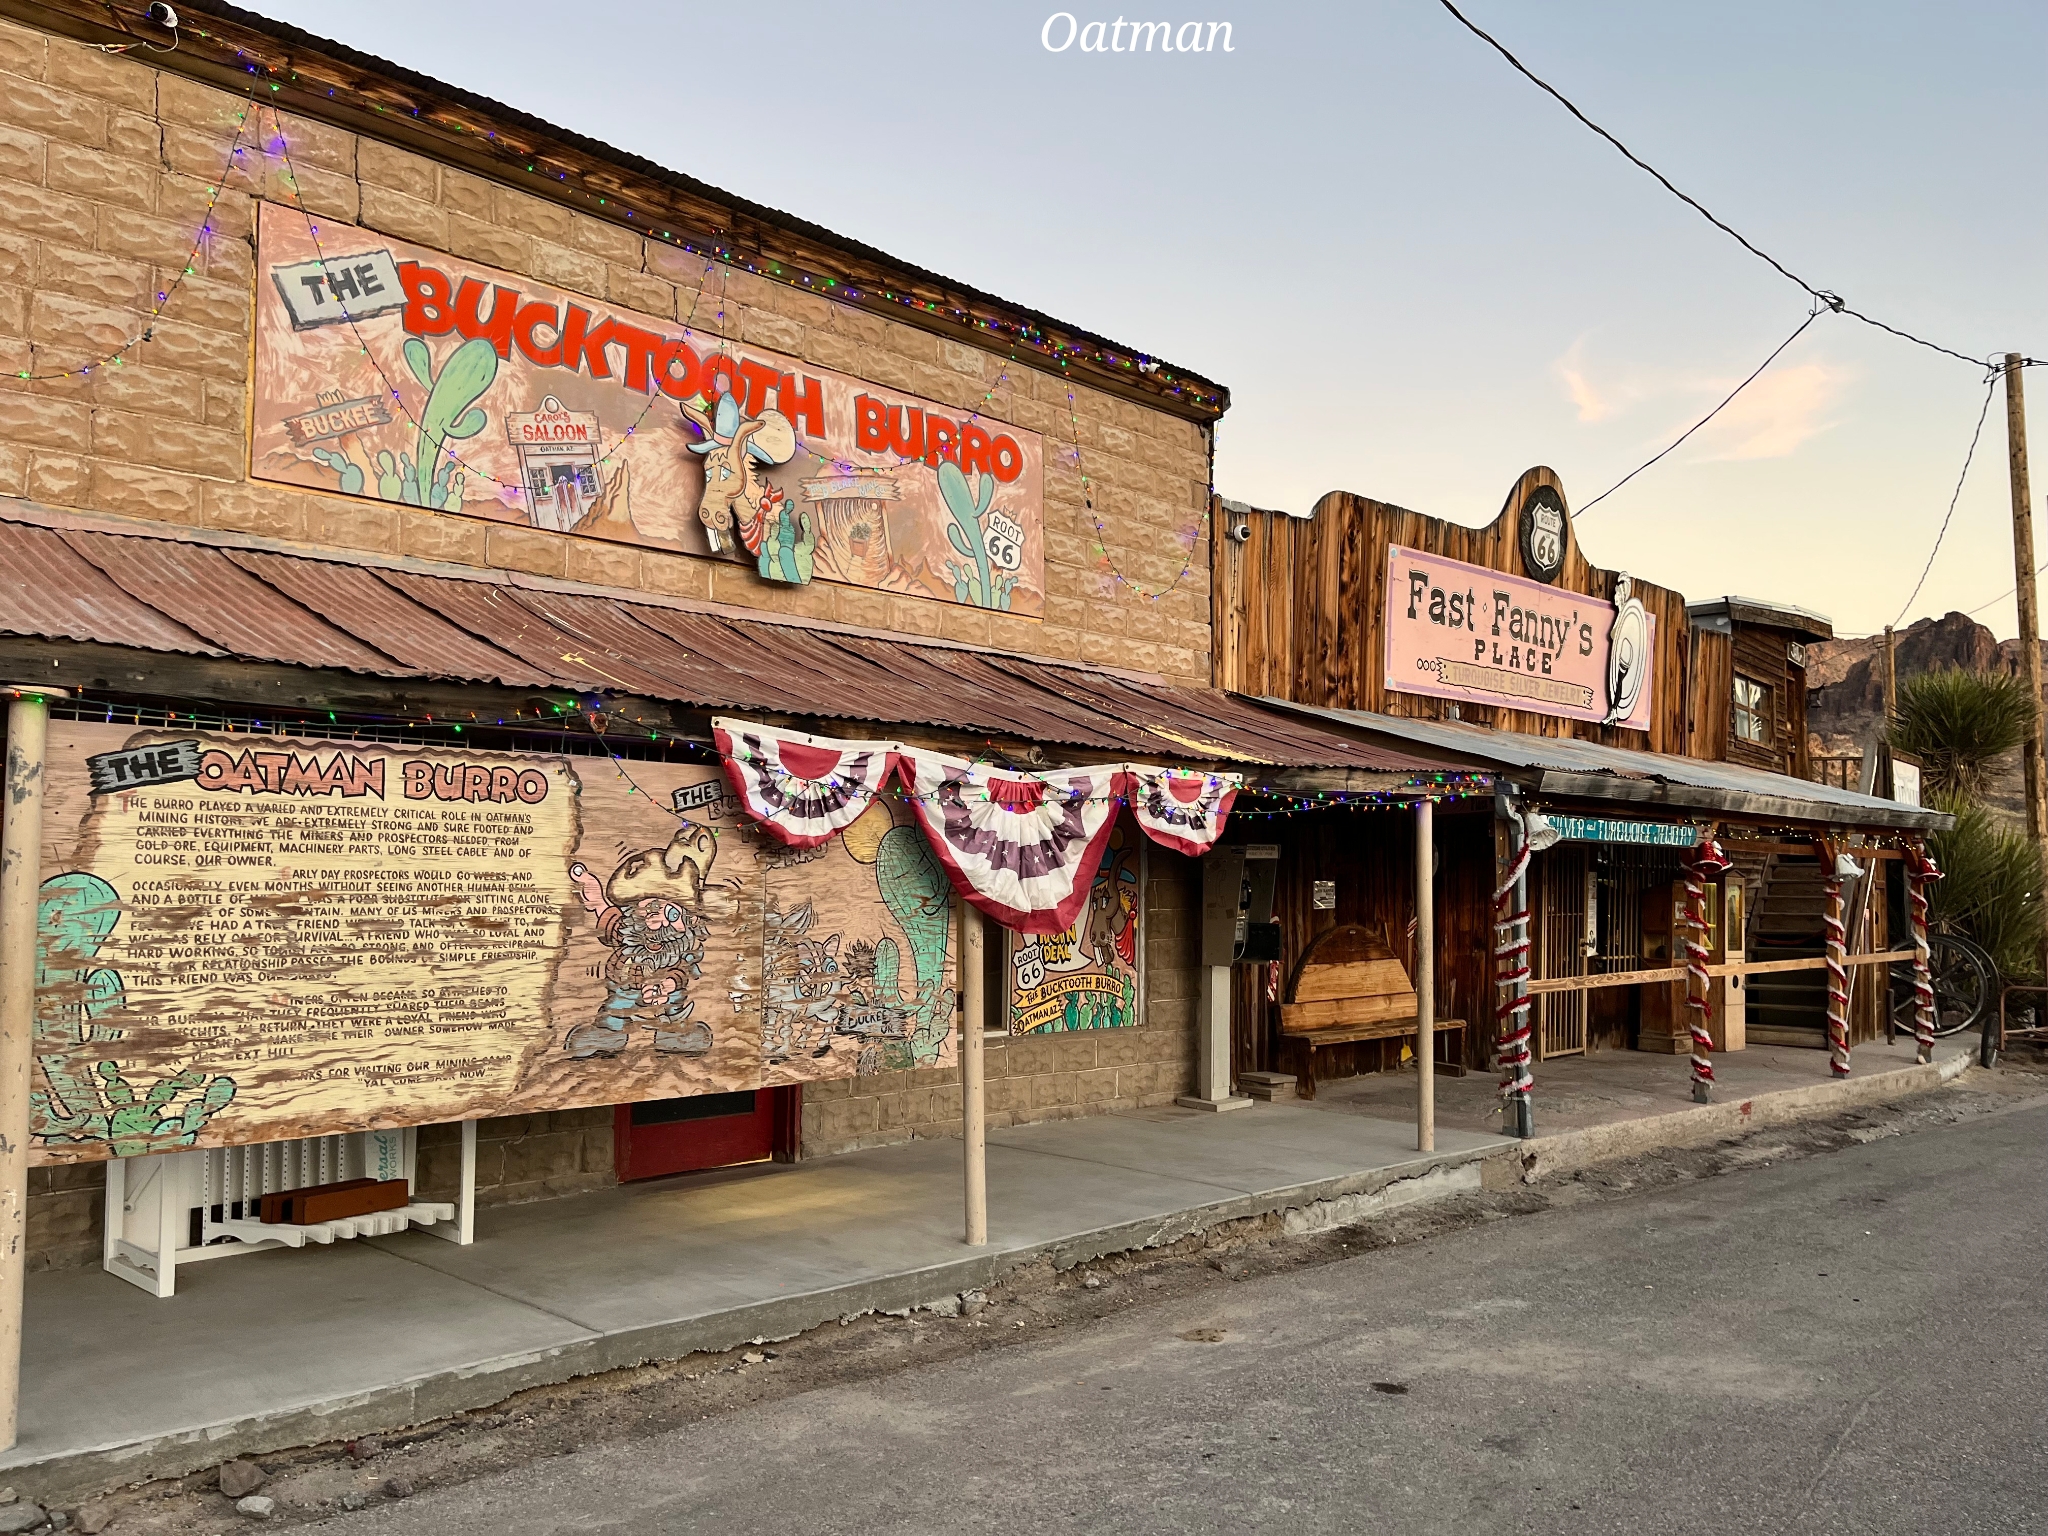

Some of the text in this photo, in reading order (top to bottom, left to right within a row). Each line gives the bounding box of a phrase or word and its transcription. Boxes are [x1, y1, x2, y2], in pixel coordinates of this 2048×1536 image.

[301, 259, 1023, 483] THE BUCKTOOTH BURRO
[523, 424, 588, 441] SALOON
[831, 477, 860, 493] BLAKE
[859, 480, 879, 497] MINE
[992, 515, 1022, 542] ROOT
[1541, 513, 1556, 528] ROUTE
[989, 536, 1015, 564] 66
[1537, 535, 1556, 563] 66
[1407, 568, 1594, 661] Fast Fanny's
[1474, 638, 1552, 674] PLACE
[1453, 665, 1584, 703] TURQUOISE SILVER JEWELRY
[108, 747, 548, 804] THE OATMAN BURRO
[678, 786, 713, 803] THE
[116, 789, 532, 823] THE BURRO PLAYED A VARIED AND EXTREMELY CRITICAL ROLE IN OATMAN'S
[139, 811, 188, 824] MINING
[304, 819, 367, 830] EXTREMELY
[371, 820, 412, 831] STRONG
[417, 822, 439, 832] AND
[443, 822, 470, 833] SURE
[473, 824, 510, 834] FOOTED
[513, 825, 534, 835] AND
[1597, 819, 1652, 844] TURQUOISE
[136, 826, 187, 838] CARRIED
[193, 828, 264, 840] EVERYTHING
[270, 830, 294, 840] THE
[300, 831, 344, 841] MINERS
[349, 832, 373, 843] AND
[377, 833, 448, 845] PROSPECTORS
[494, 837, 519, 847] FROM
[136, 840, 532, 858] GOLD ORE, EQUIPMENT, MACHINERY PARTS, LONG STEEL CABLE AND OF
[134, 853, 277, 868] COURSE, OUR OWNER.
[320, 869, 341, 880] DAY
[344, 870, 410, 881] PROSPECTORS
[413, 870, 452, 881] WOULD
[456, 870, 471, 881] GO
[511, 872, 533, 882] AND
[228, 881, 505, 893] EVEN MONTHS WITHOUT SEEING ANOTHER HUMAN
[131, 894, 160, 905] AND
[163, 894, 174, 905] A
[177, 894, 222, 905] BOTTLE
[475, 895, 514, 905] SITTING
[517, 894, 550, 904] ALONE
[218, 907, 236, 917] OF
[350, 907, 383, 916] MANY
[387, 906, 400, 916] OF
[402, 907, 418, 916] US
[466, 906, 488, 916] AND
[210, 920, 239, 930] HAD
[242, 920, 253, 930] A
[296, 919, 340, 930] FRIEND
[409, 918, 435, 929] TALK
[194, 933, 227, 944] RELY
[367, 930, 410, 941] FRIEND
[414, 929, 440, 940] WHO
[523, 928, 545, 937] AND
[127, 947, 164, 958] HARD
[169, 946, 239, 959] WORKING,
[242, 946, 259, 957] SO
[413, 942, 434, 951] AND
[339, 955, 364, 966] THE
[439, 952, 477, 962] SIMPLE
[1017, 948, 1039, 965] ROOT
[1043, 944, 1073, 966] DEAL
[170, 971, 253, 986] FRIEND WAS
[1022, 962, 1041, 985] 66
[421, 988, 436, 999] SO
[1025, 976, 1121, 1005] THE BUCKTOOTH BURRO
[317, 1018, 346, 1030] THEY
[350, 1016, 382, 1028] WERE
[385, 1015, 394, 1026] A
[396, 1012, 432, 1025] LOYAL
[384, 1026, 425, 1037] OWNER
[329, 1068, 351, 1079] FOR
[406, 1061, 431, 1073] OUR
